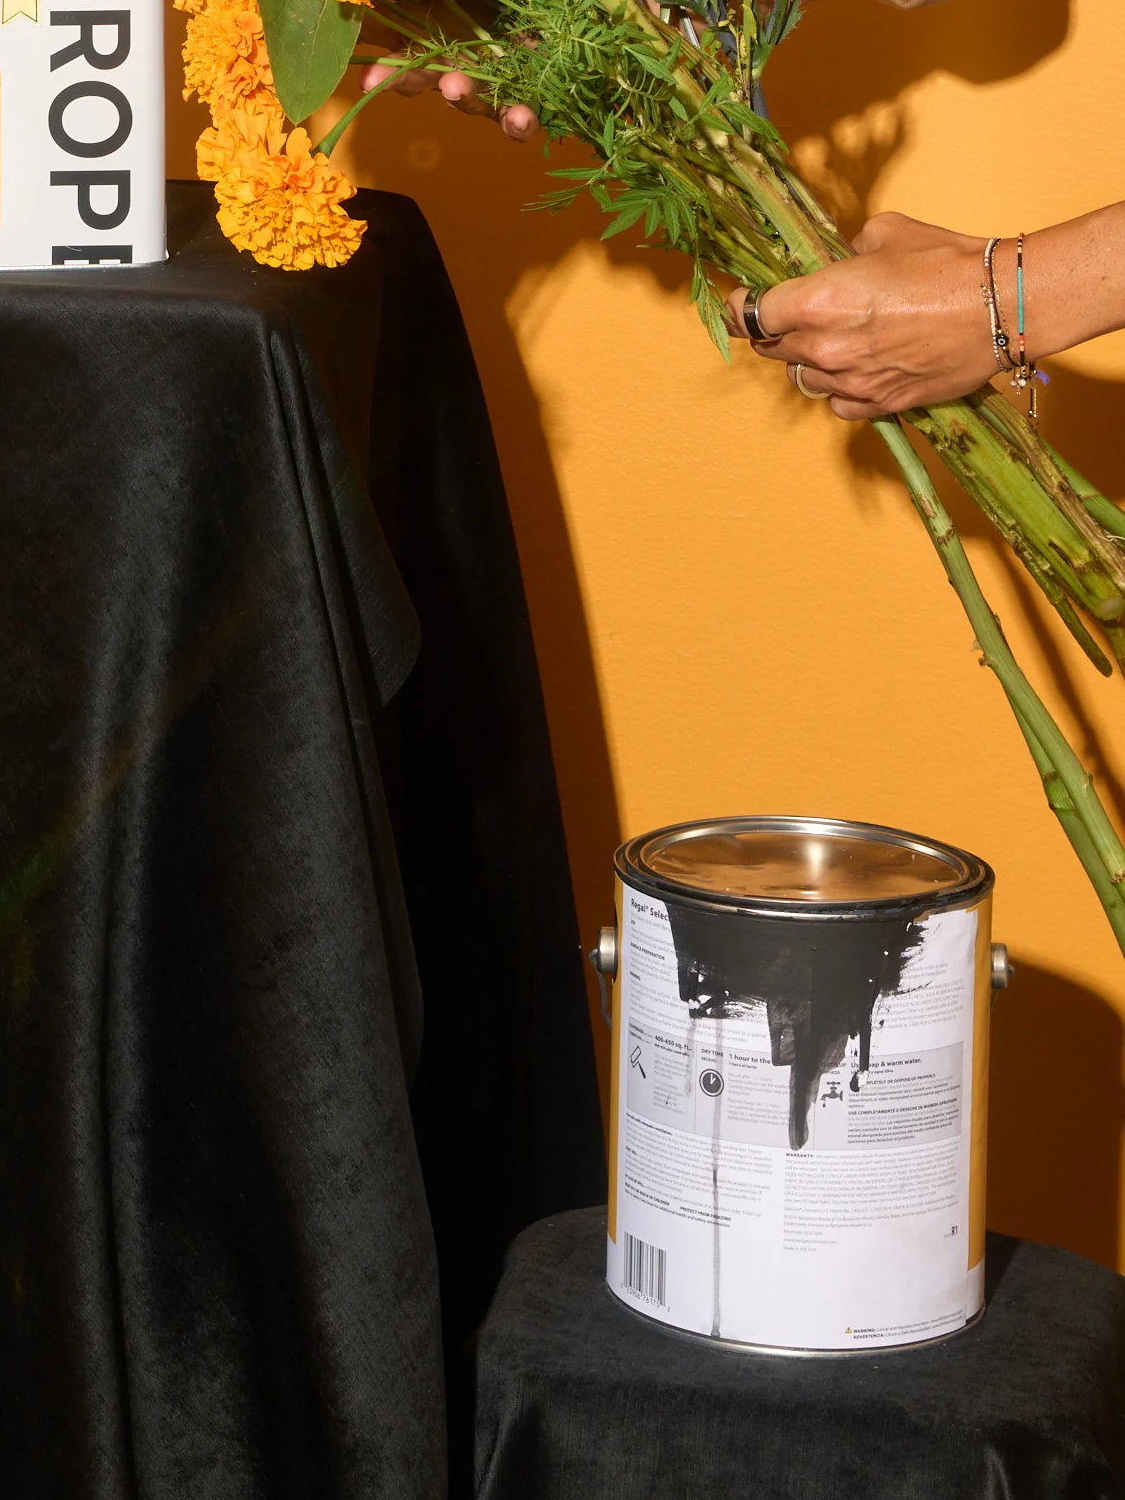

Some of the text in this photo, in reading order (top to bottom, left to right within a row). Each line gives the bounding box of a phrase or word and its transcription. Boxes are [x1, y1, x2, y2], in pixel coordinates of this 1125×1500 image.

[650, 907, 670, 921] Selec
[734, 1054, 750, 1062] hour
[680, 1206, 697, 1214] PROTECT
